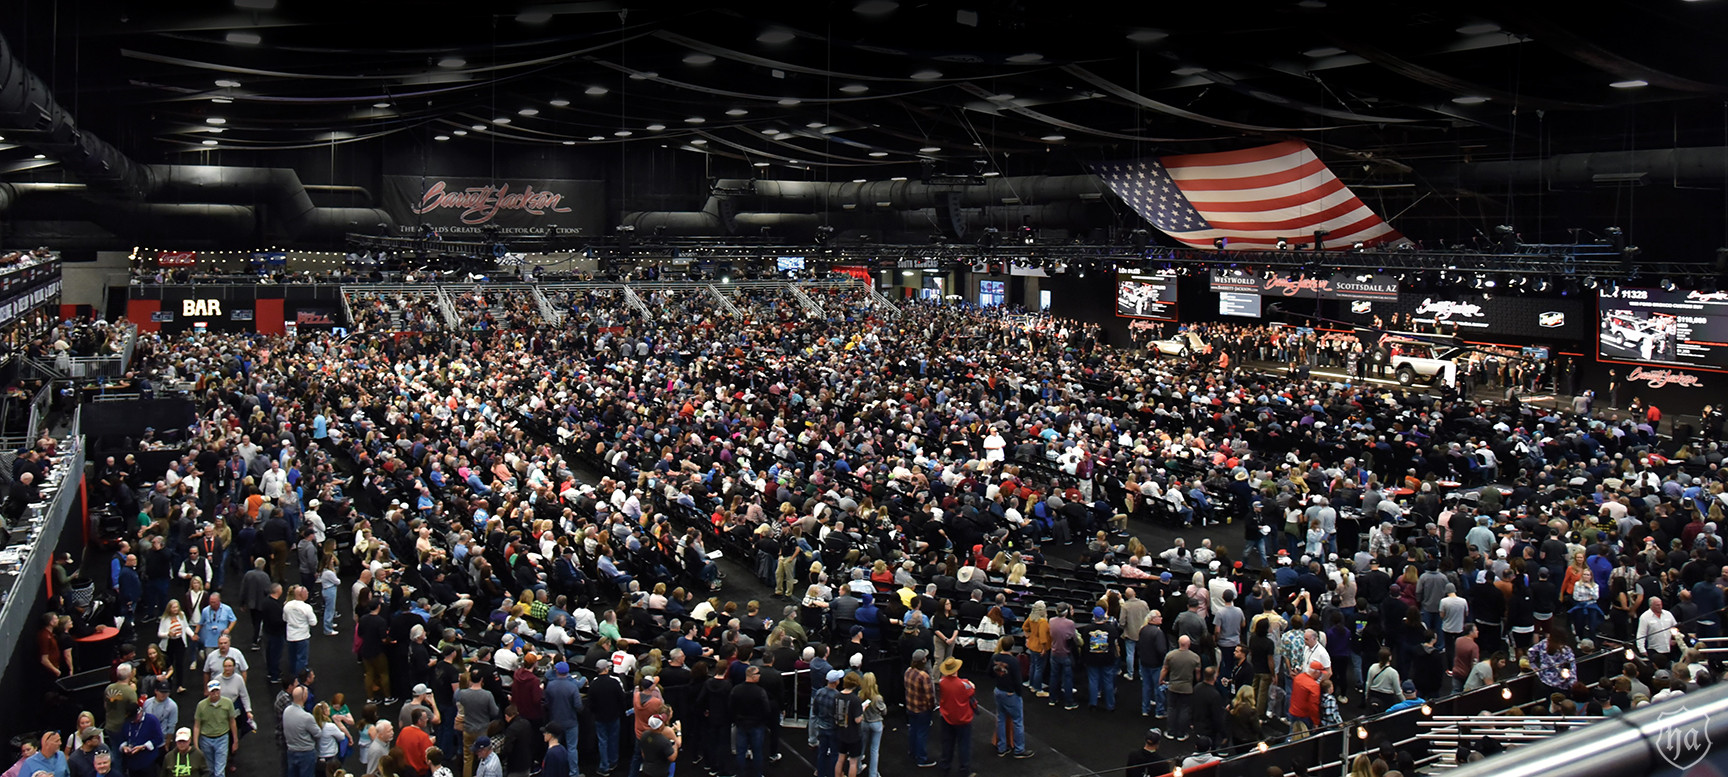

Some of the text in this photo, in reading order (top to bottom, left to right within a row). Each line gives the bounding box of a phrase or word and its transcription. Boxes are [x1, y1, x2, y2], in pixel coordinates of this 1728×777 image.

[411, 180, 572, 225] Barrett-Jackson
[450, 226, 483, 234] GREATES
[182, 299, 222, 316] BAR
